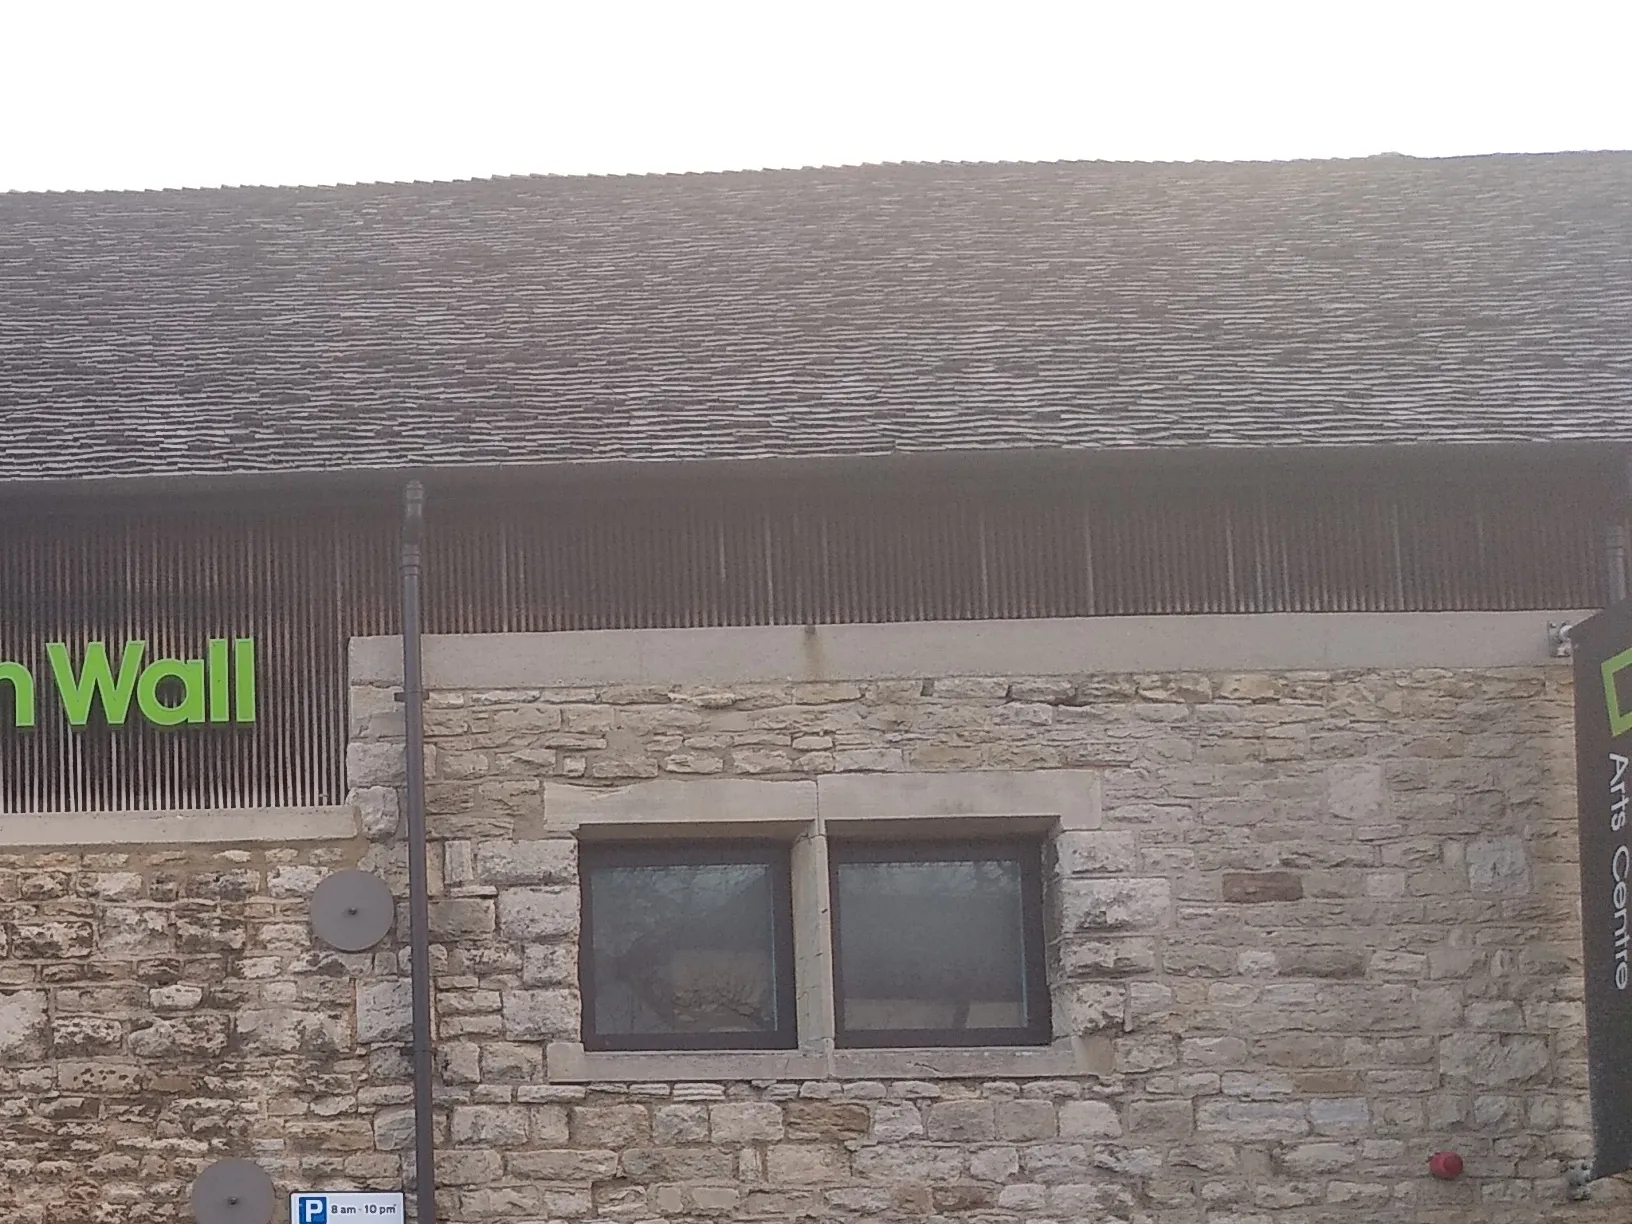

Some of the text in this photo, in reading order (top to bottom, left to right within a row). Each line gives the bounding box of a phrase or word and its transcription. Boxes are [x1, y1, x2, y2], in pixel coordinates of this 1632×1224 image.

[45, 637, 256, 728] Wall
[1608, 751, 1630, 991] Arts Centre
[305, 1199, 323, 1223] P
[330, 1205, 338, 1214] 8
[340, 1206, 356, 1214] am
[364, 1204, 377, 1214] 10
[379, 1205, 396, 1216] pm
